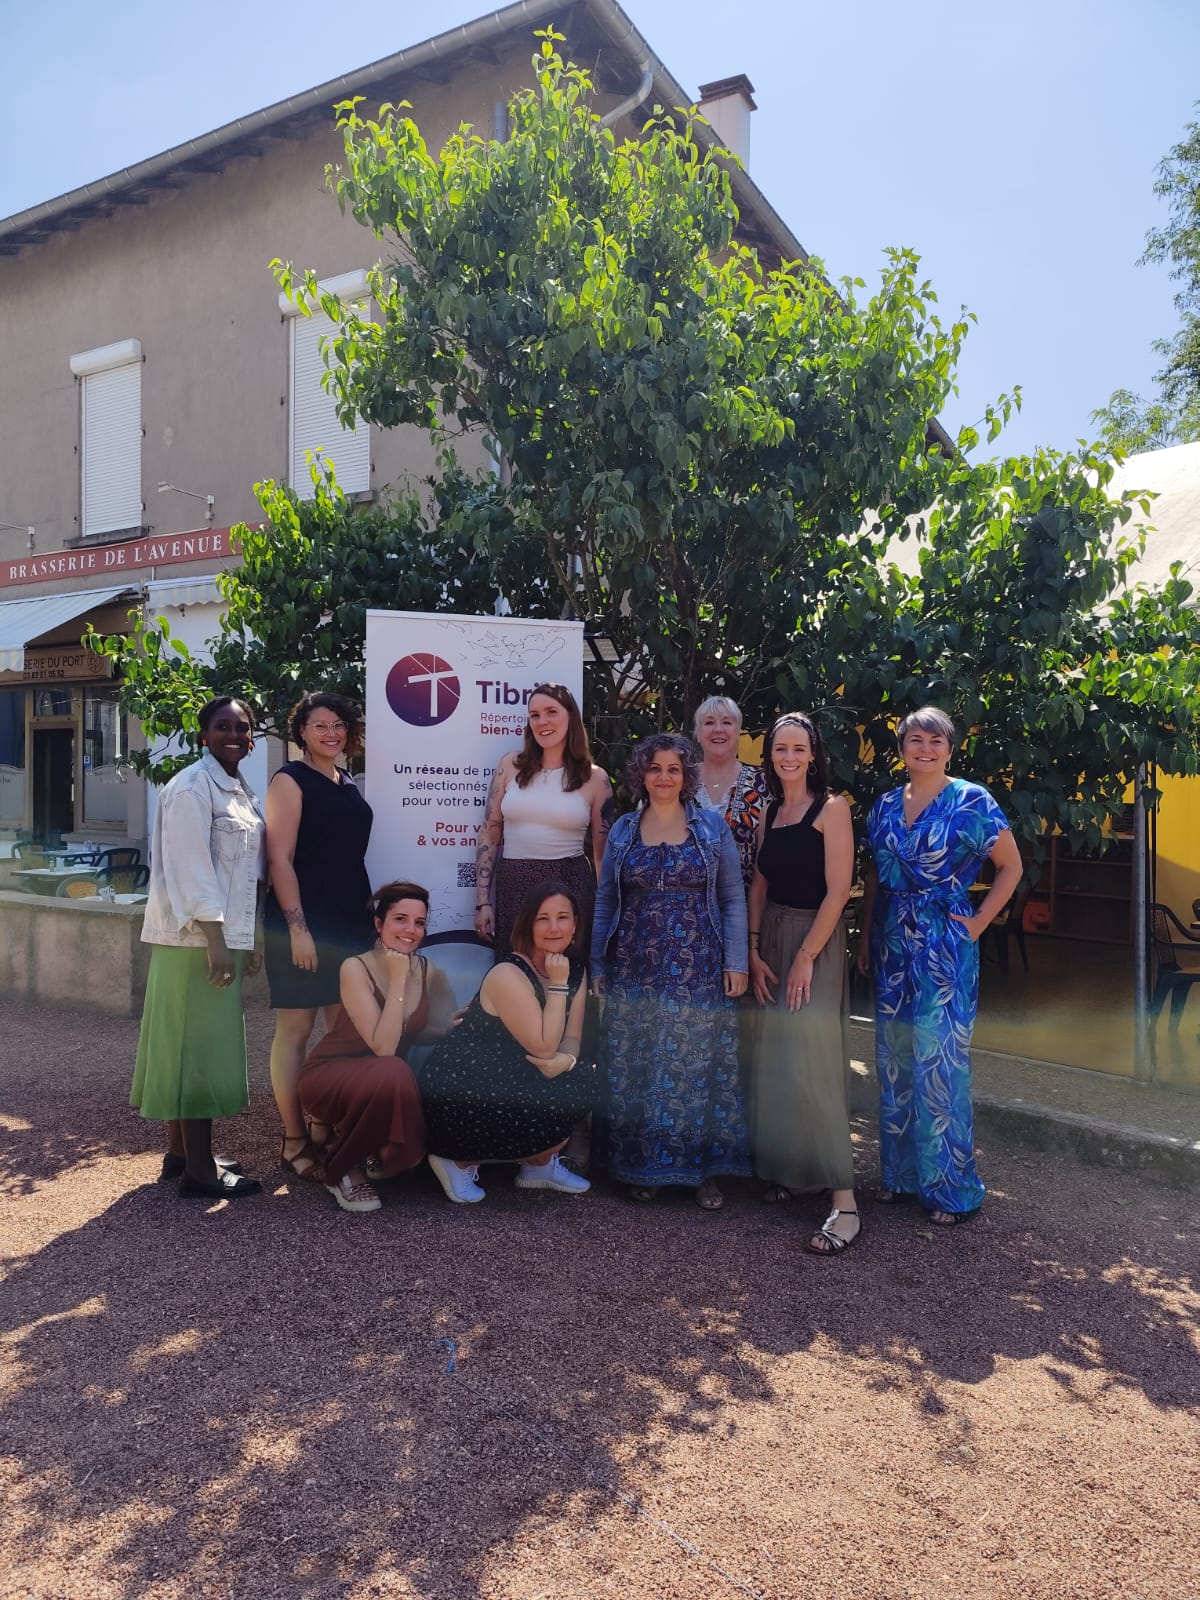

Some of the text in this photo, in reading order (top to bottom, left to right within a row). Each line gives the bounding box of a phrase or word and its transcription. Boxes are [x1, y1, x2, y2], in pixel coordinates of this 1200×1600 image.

[9, 534, 223, 580] BRASSERIE DE L'AVENUE
[24, 654, 85, 670] SERIE DU PORT
[475, 680, 540, 706] Tibr
[480, 712, 530, 724] Répertoi
[394, 763, 412, 775] Un
[415, 764, 459, 775] réseau
[463, 765, 480, 776] de
[408, 780, 488, 792] sélectionnés
[402, 796, 486, 808] pour votre bi
[435, 822, 482, 833] Pour v
[417, 835, 477, 847] & vos an
